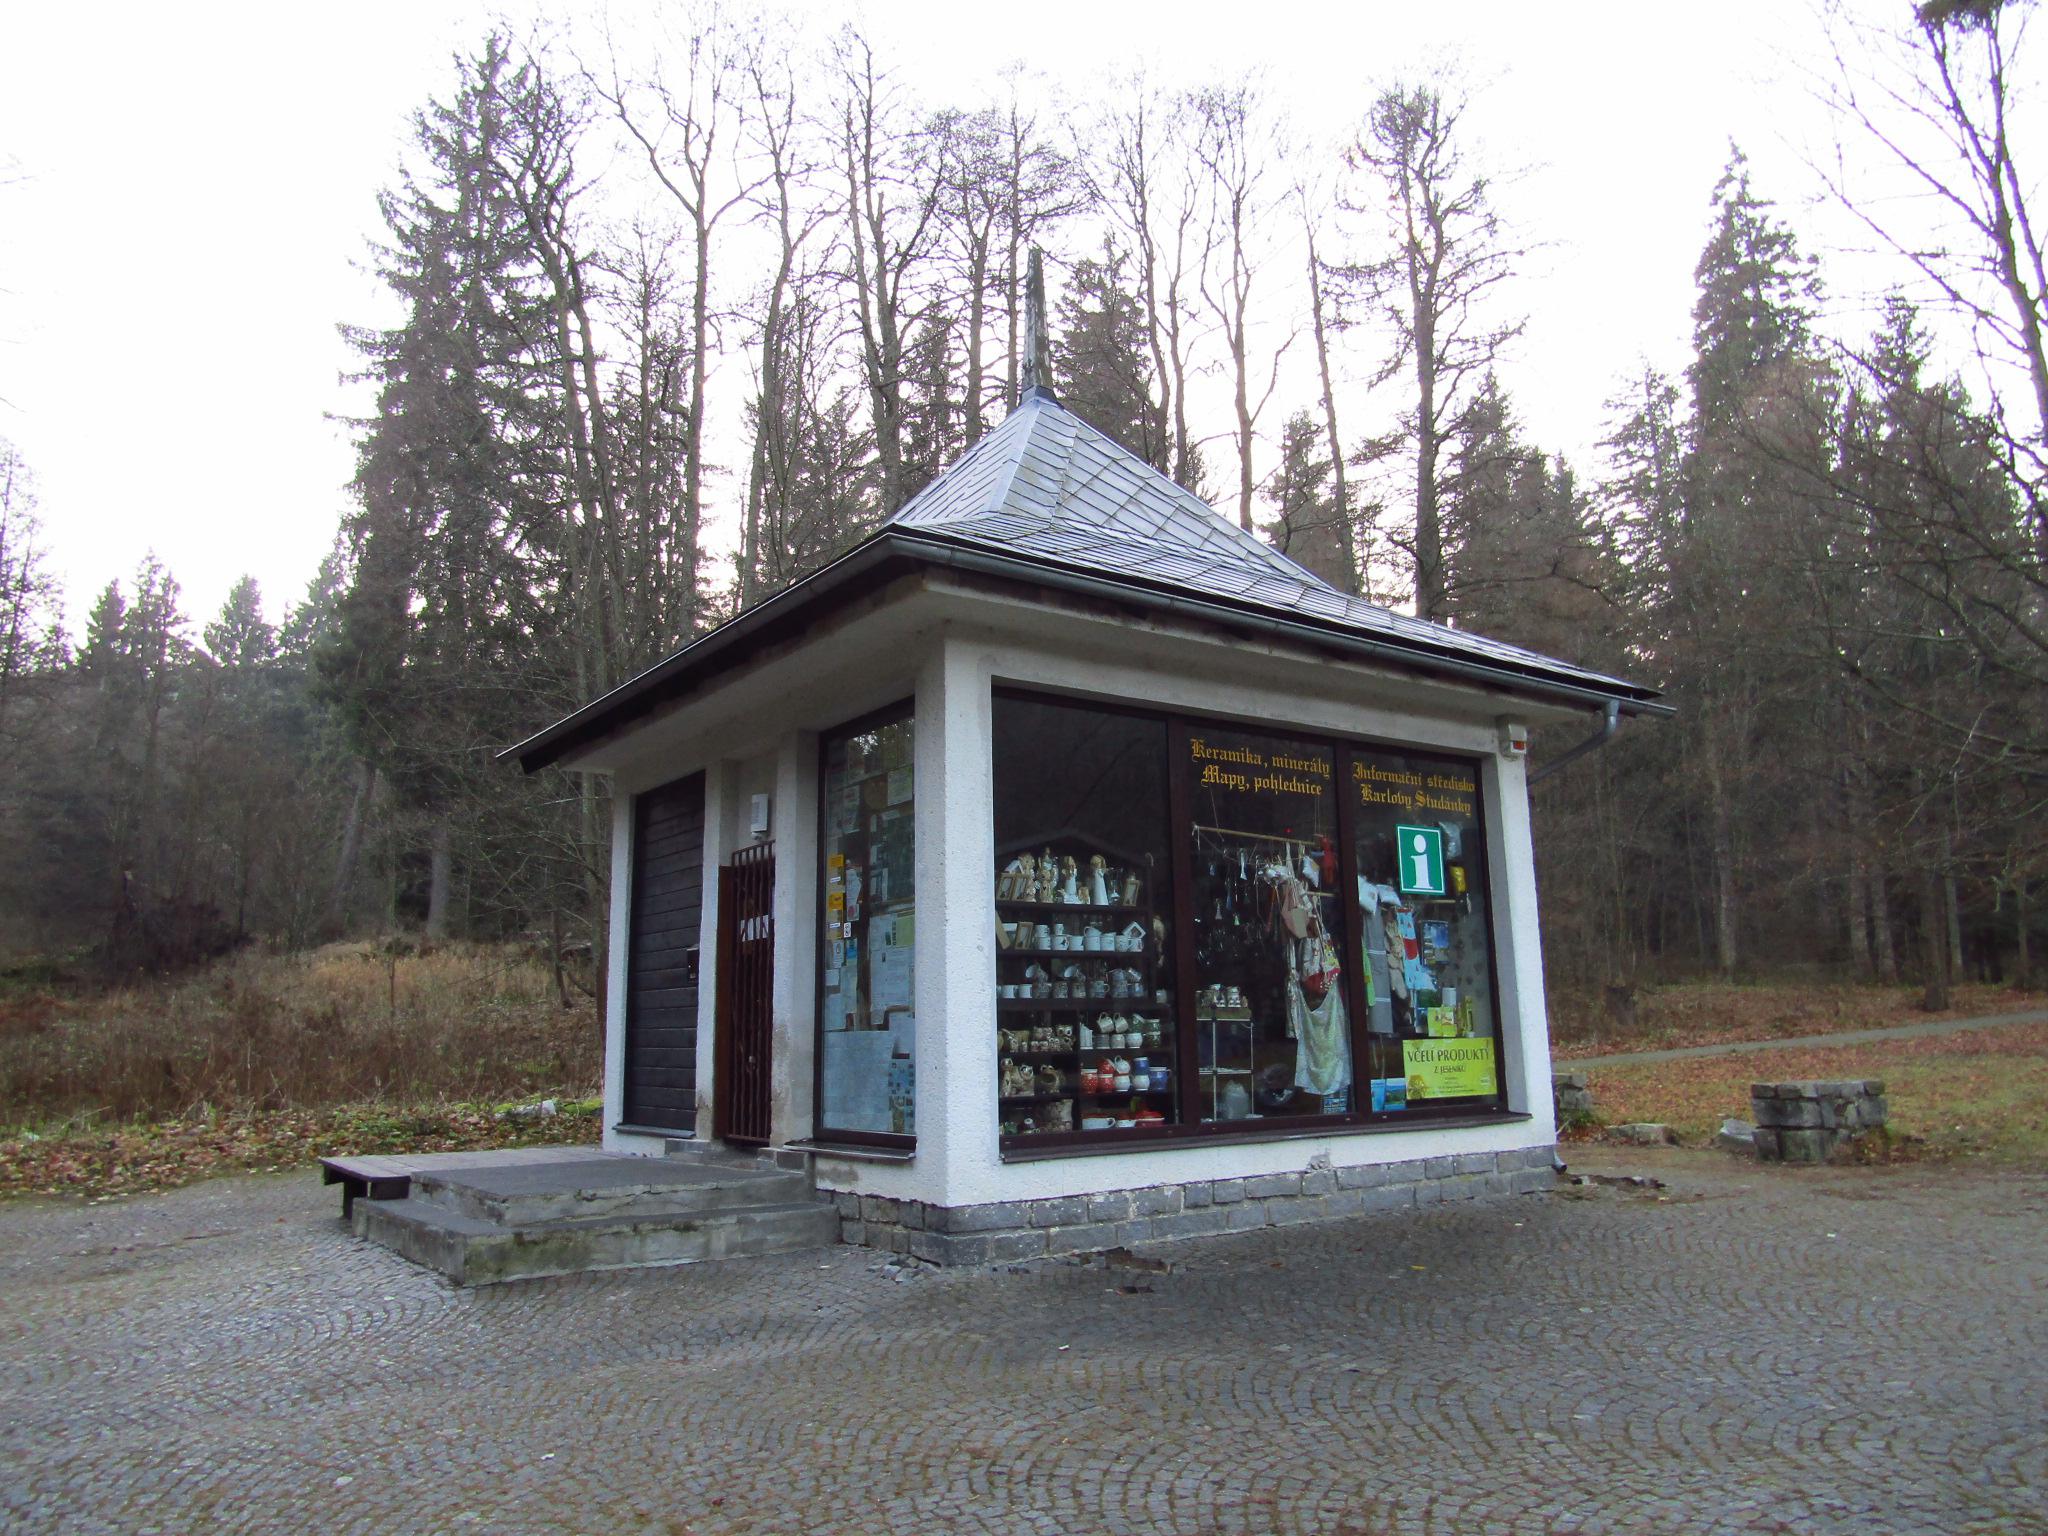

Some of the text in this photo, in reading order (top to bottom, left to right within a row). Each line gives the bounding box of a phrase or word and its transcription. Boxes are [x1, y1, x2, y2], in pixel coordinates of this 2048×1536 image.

[1190, 738, 1330, 779] Keramika, minerály
[1200, 764, 1322, 795] Mapy, pohlednice
[1360, 783, 1412, 809] Karlovy
[1437, 1048, 1489, 1061] PRODUKTY
